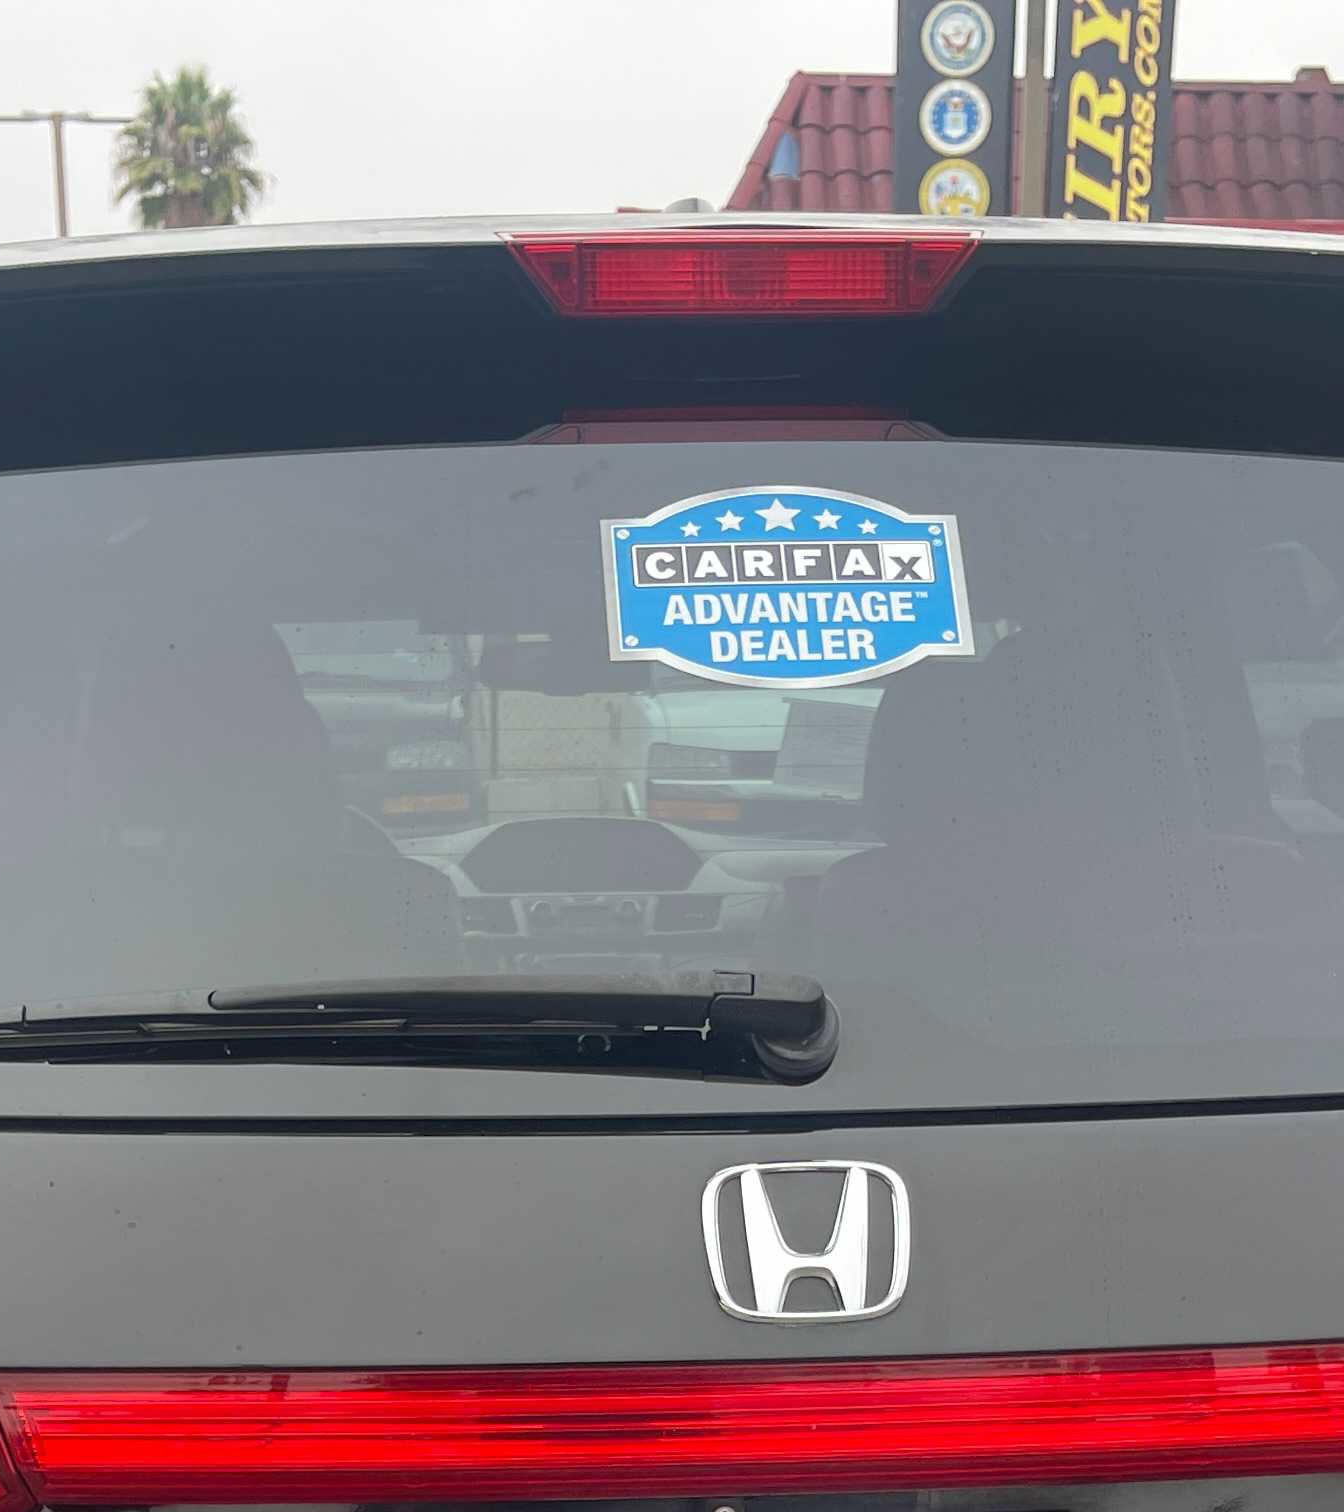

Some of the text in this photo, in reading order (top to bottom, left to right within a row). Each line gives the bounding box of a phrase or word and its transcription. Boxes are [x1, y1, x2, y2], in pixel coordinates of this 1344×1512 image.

[1064, 0, 1131, 223] IRY
[644, 547, 924, 581] CARFAX
[709, 628, 877, 662] DEALER
